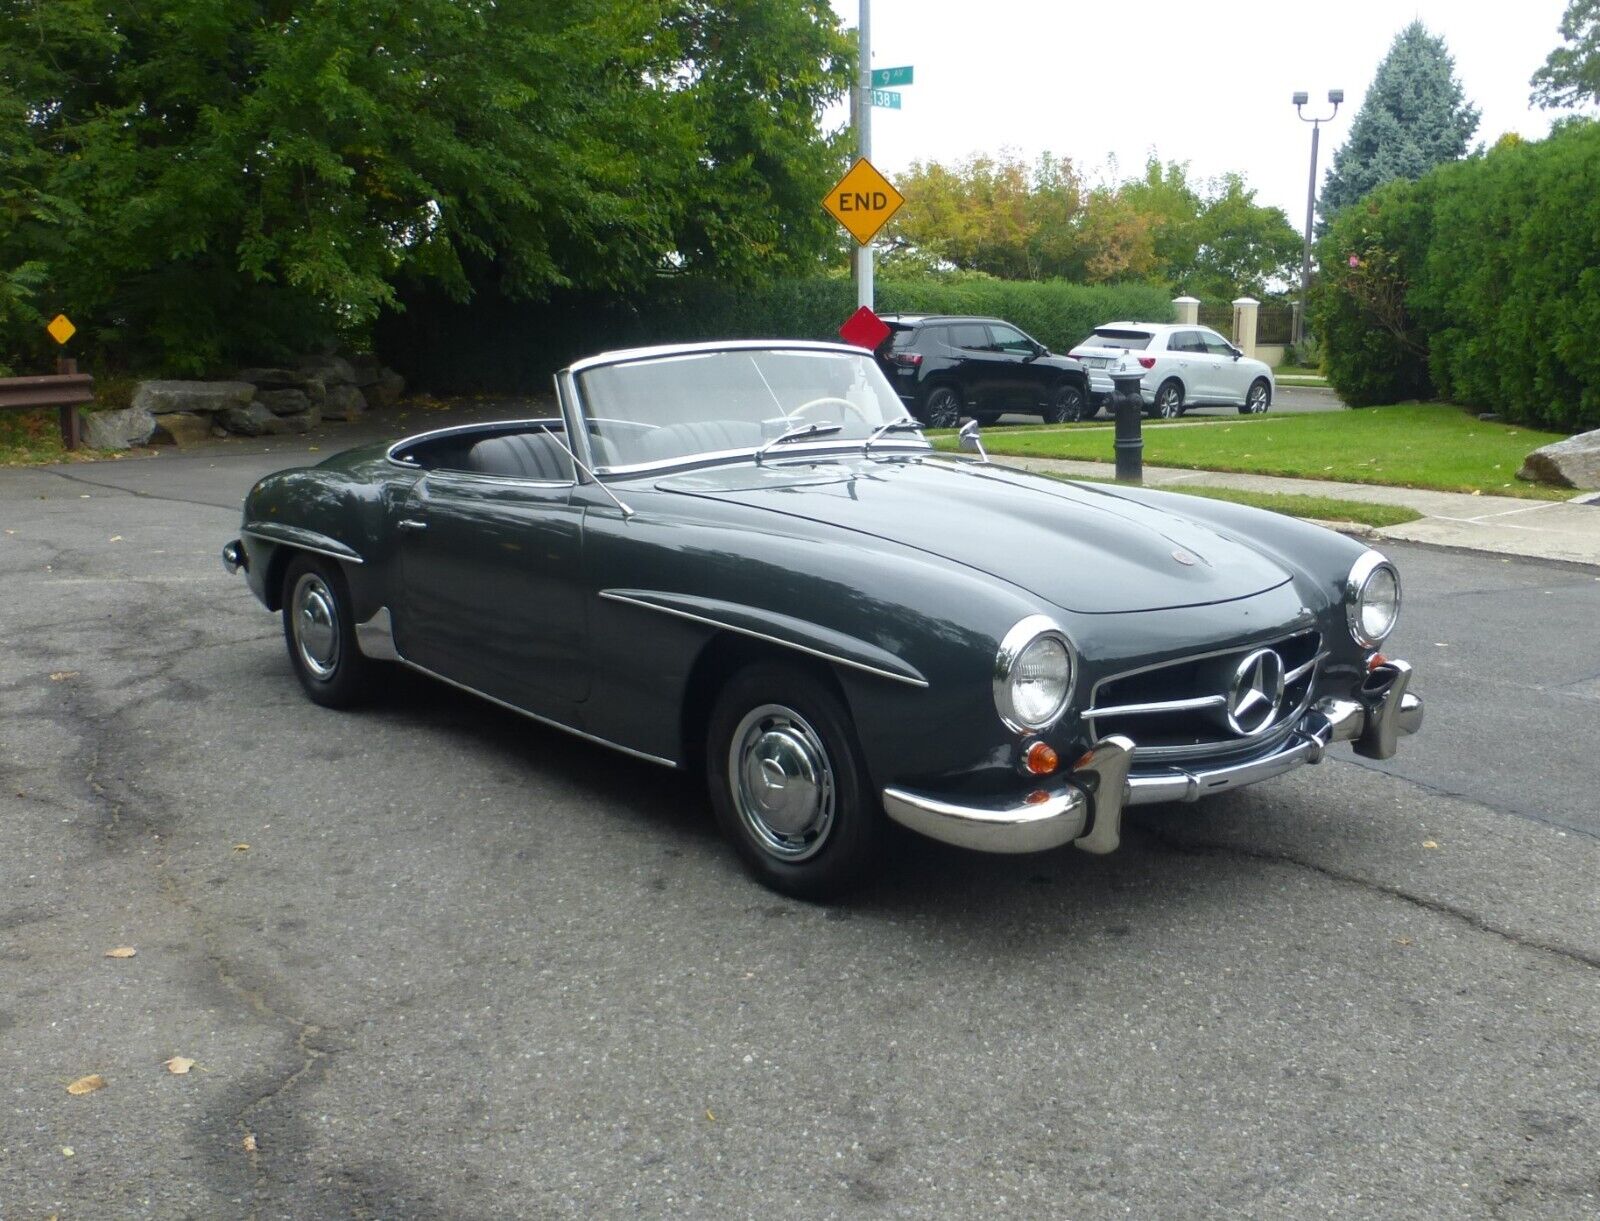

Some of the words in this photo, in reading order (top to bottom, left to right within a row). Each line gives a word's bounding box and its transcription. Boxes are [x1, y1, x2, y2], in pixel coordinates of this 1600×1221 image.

[882, 71, 890, 85] 9
[873, 90, 890, 107] 138
[839, 192, 887, 212] END
